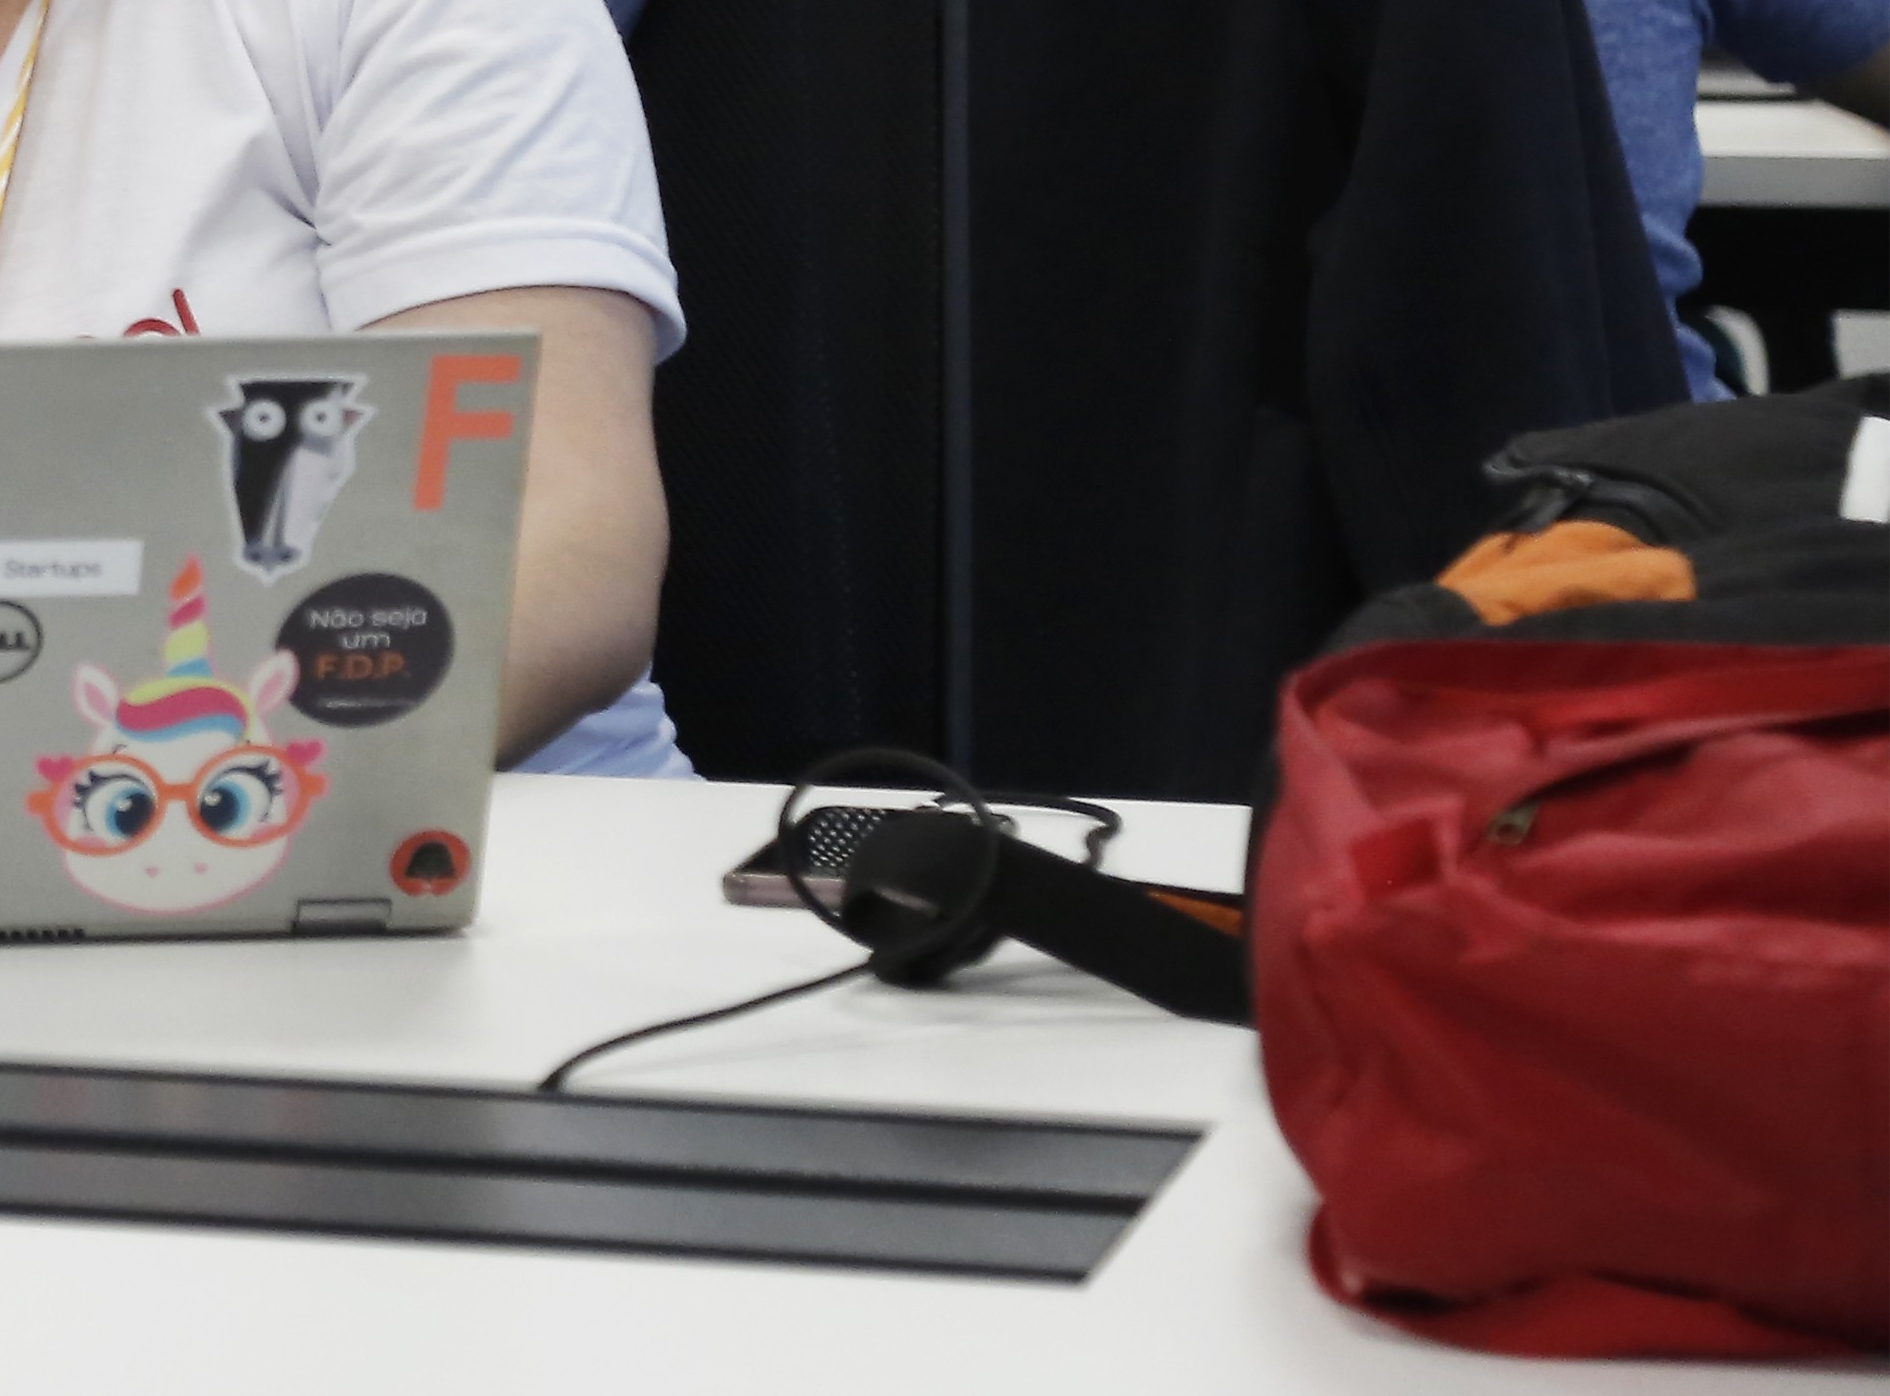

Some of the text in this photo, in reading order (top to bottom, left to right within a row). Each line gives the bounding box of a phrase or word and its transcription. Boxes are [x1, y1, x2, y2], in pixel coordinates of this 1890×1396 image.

[412, 355, 522, 511] F
[2, 559, 102, 584] Startups
[309, 606, 428, 630] Não seja
[341, 632, 391, 650] um
